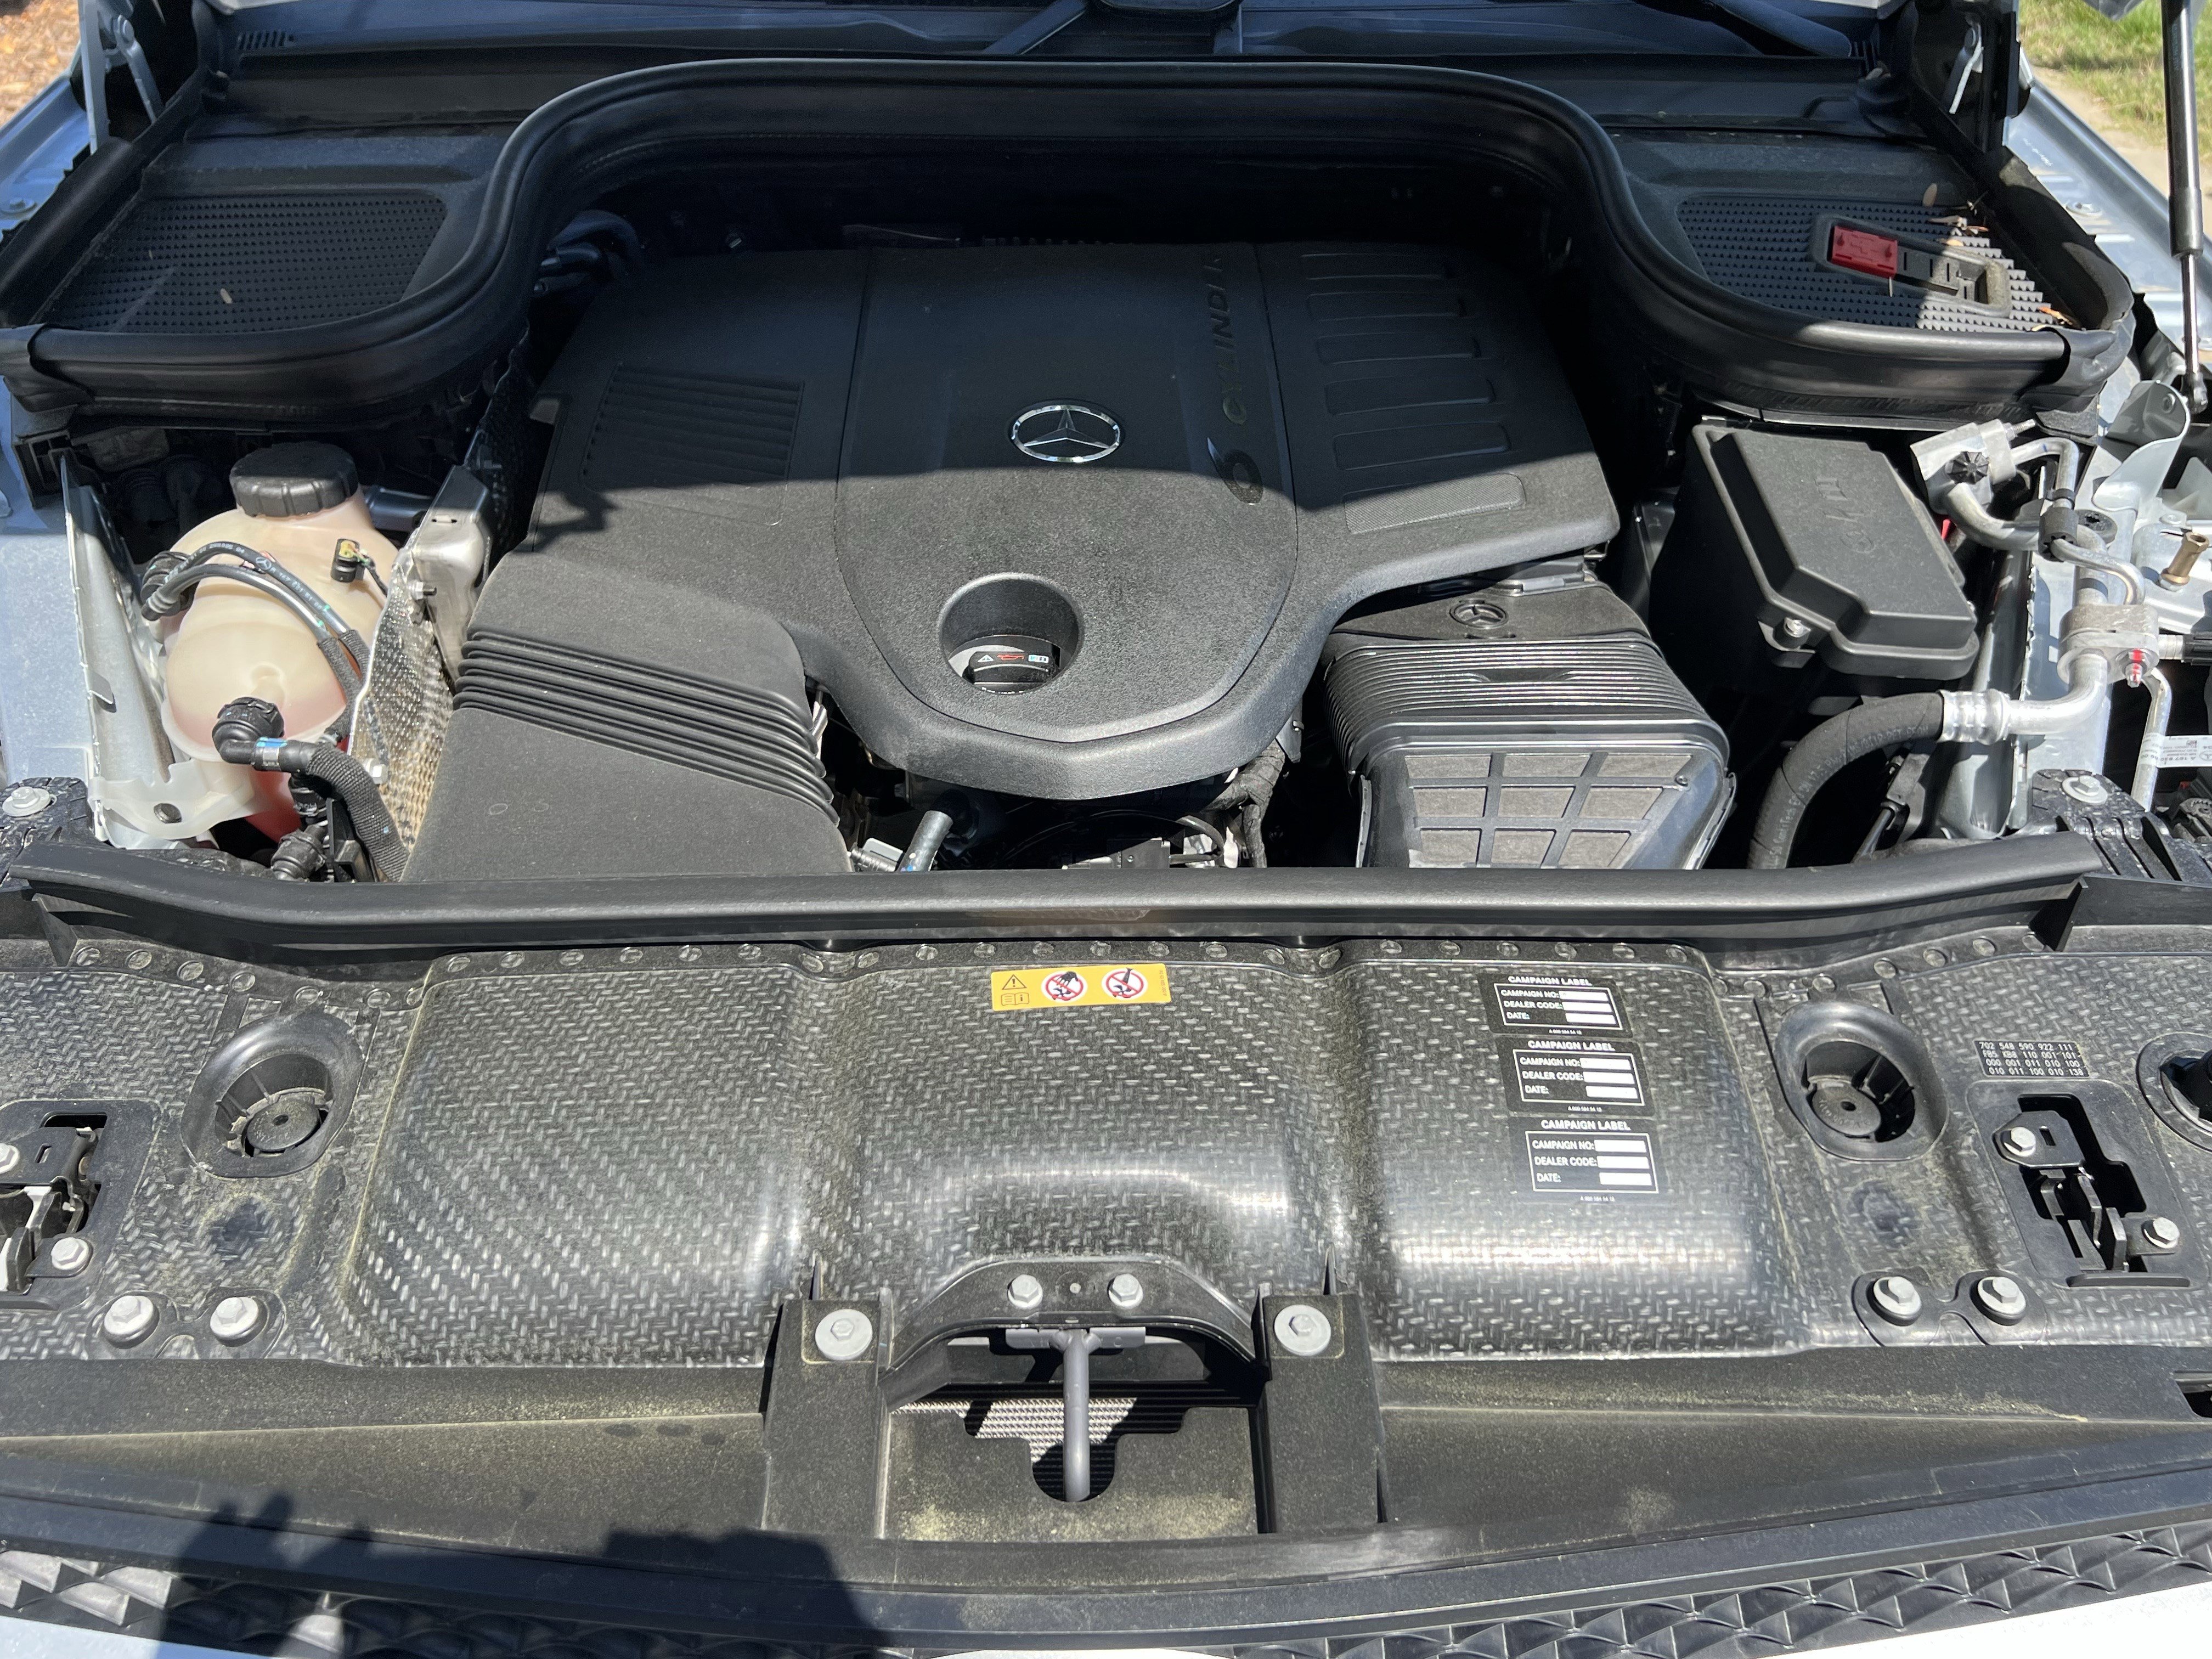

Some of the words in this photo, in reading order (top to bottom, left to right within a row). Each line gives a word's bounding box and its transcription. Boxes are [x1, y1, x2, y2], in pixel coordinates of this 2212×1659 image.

[1207, 437, 1263, 505] 6
[1508, 975, 1560, 985] CAMPAIGN
[1561, 978, 1593, 986] LABEL
[1501, 989, 1544, 997] CAMPAIGN
[1503, 1000, 1536, 1008] DEALER
[1537, 1001, 1563, 1009] CODE:
[1506, 1012, 1531, 1020] DATE:
[1528, 1040, 1582, 1050] CAMPAIGN
[1582, 1042, 1616, 1052] LABEL
[1978, 1042, 1995, 1050] 702
[2018, 1042, 2035, 1051] 590
[2041, 1051, 2057, 1059] 001
[1519, 1057, 1564, 1066] CAMPAIGN
[1564, 1058, 1581, 1067] NO:
[1985, 1058, 2002, 1066] 000
[2045, 1059, 2061, 1068] 010
[1521, 1070, 1556, 1080] DEALER
[1556, 1071, 1584, 1081] CODE:
[2029, 1068, 2045, 1076] 100
[1524, 1085, 1549, 1094] DATE:
[1541, 1119, 1596, 1130] CAMPAIGN
[1597, 1121, 1632, 1131] LABEL
[1532, 1140, 1578, 1150] CAMPAIGN
[1578, 1141, 1595, 1150] NO:
[1534, 1156, 1569, 1166] DEALER
[1569, 1156, 1597, 1166] CODE:
[1536, 1172, 1562, 1182] DATE:
